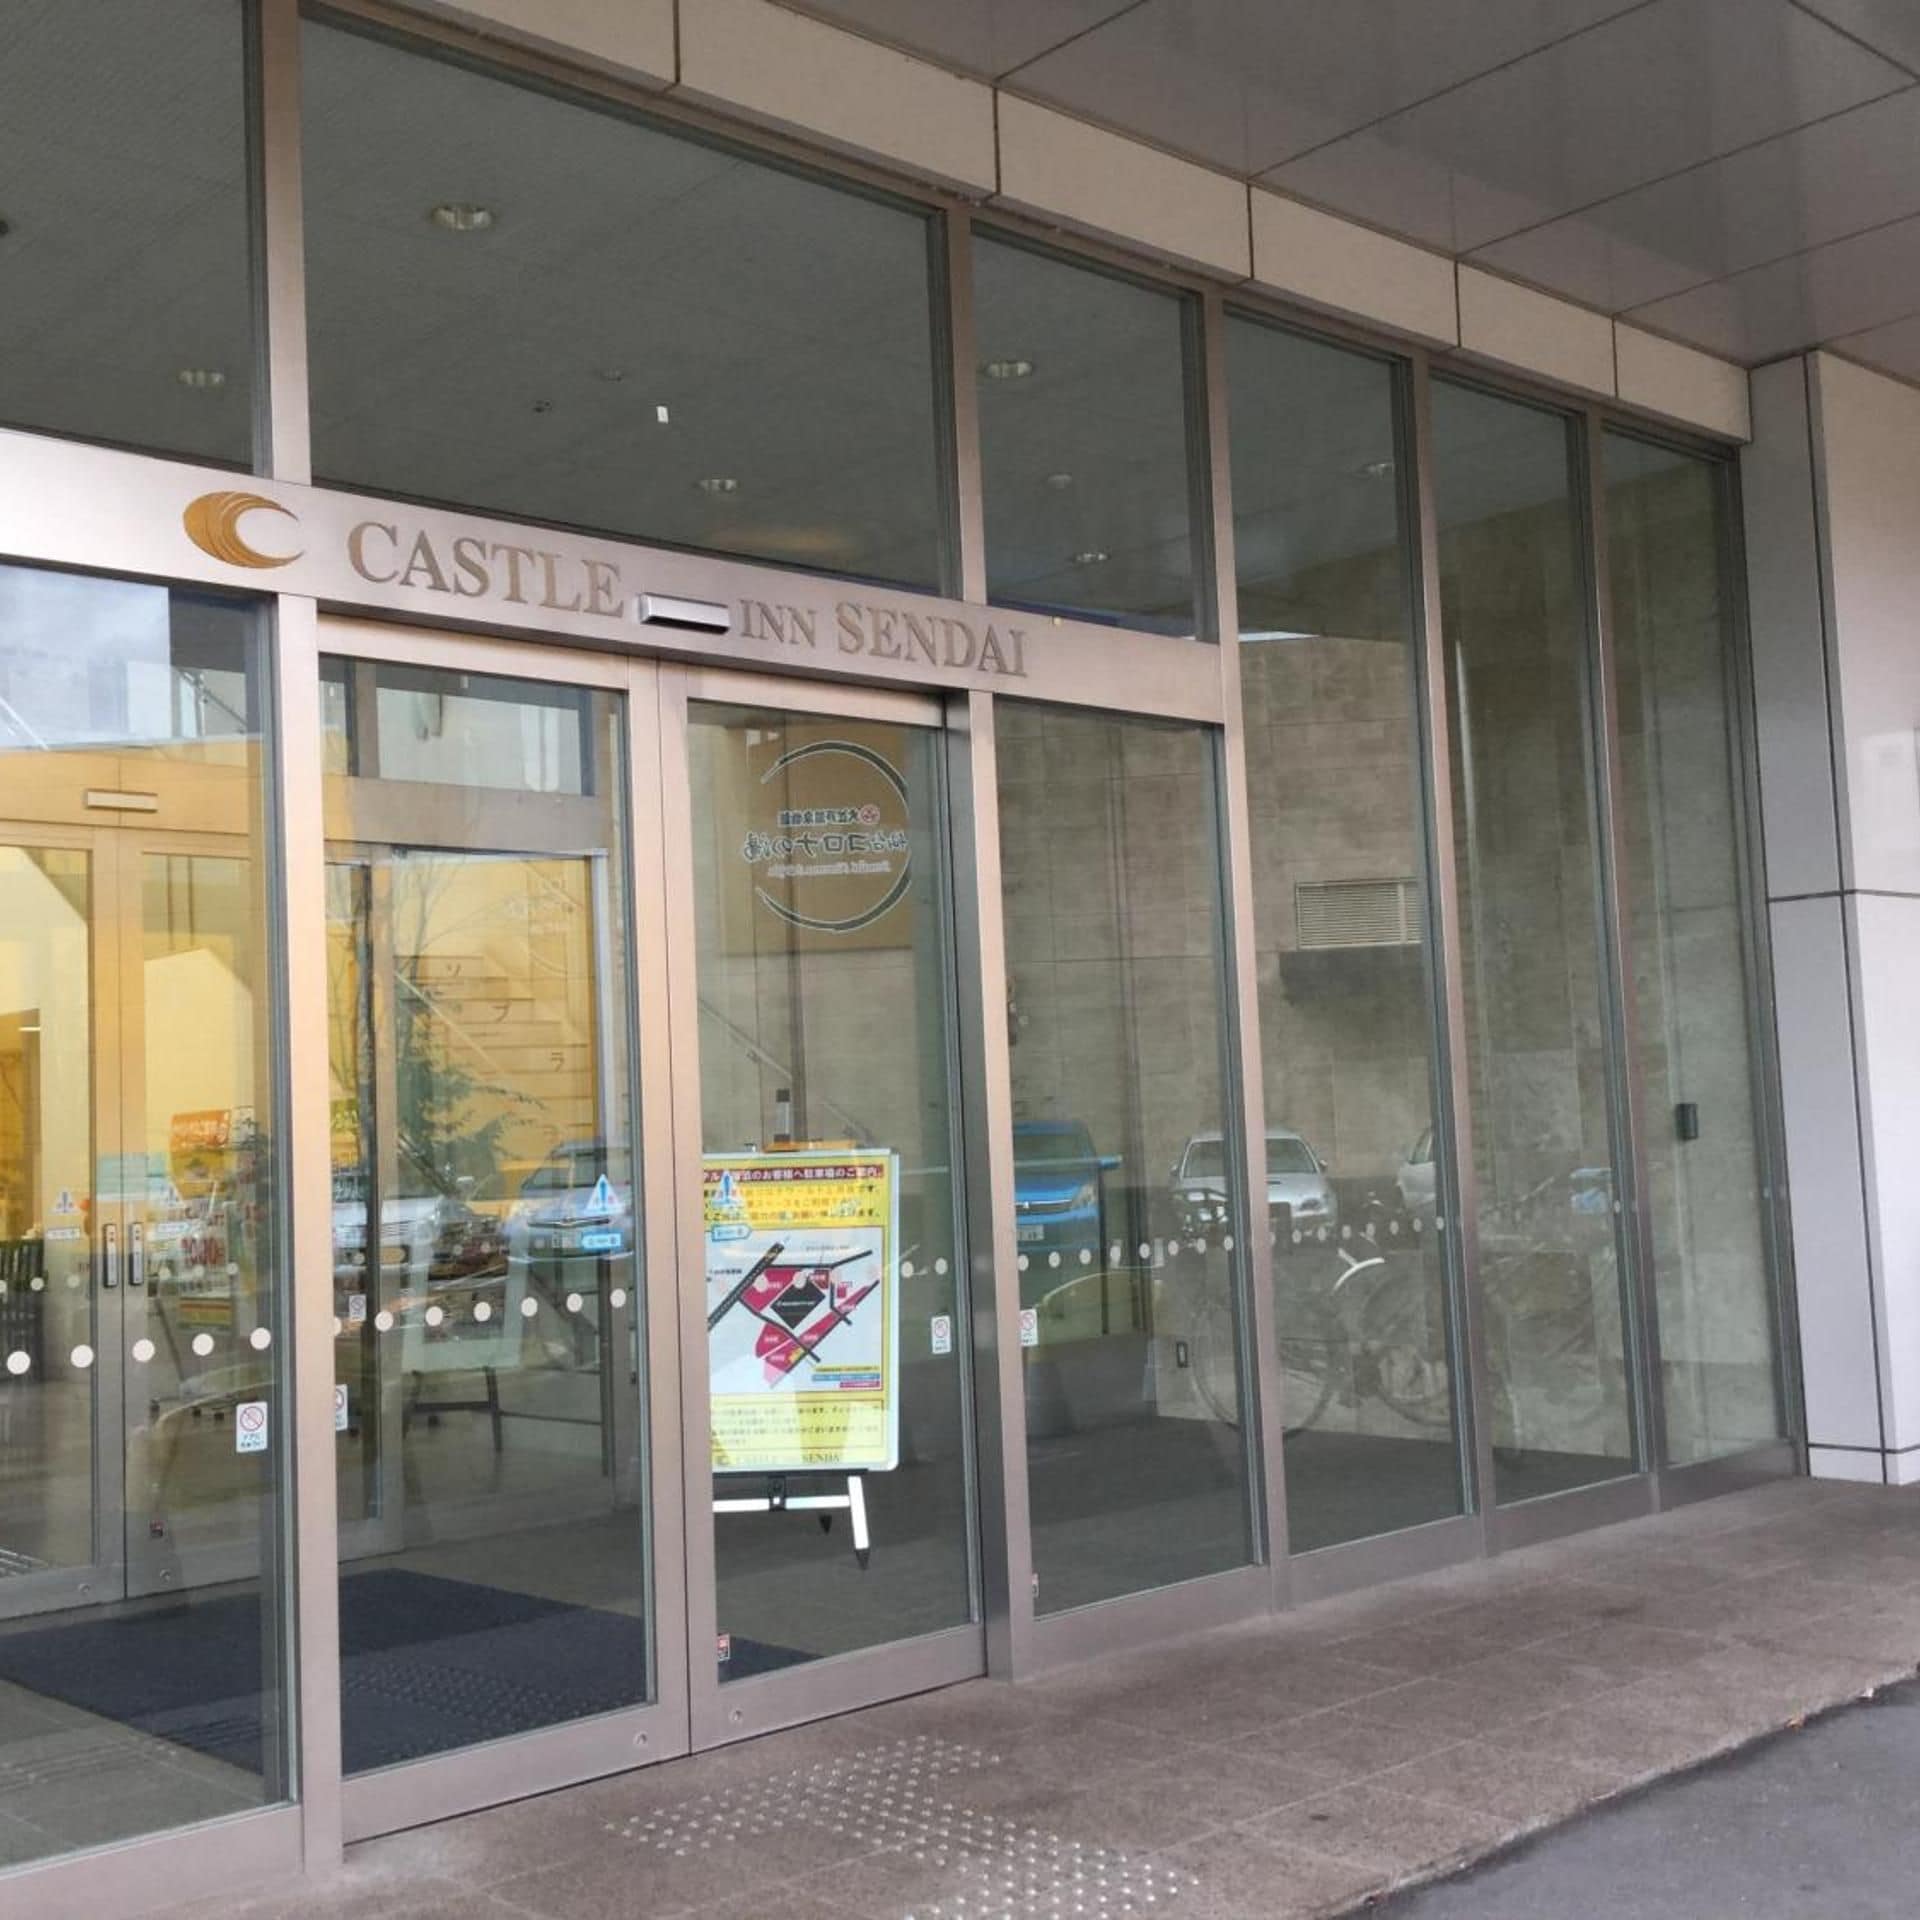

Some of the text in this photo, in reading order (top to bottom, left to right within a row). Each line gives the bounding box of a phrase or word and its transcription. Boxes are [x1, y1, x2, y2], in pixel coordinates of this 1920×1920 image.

[346, 521, 1028, 678] CASTLE INN SENDAI
